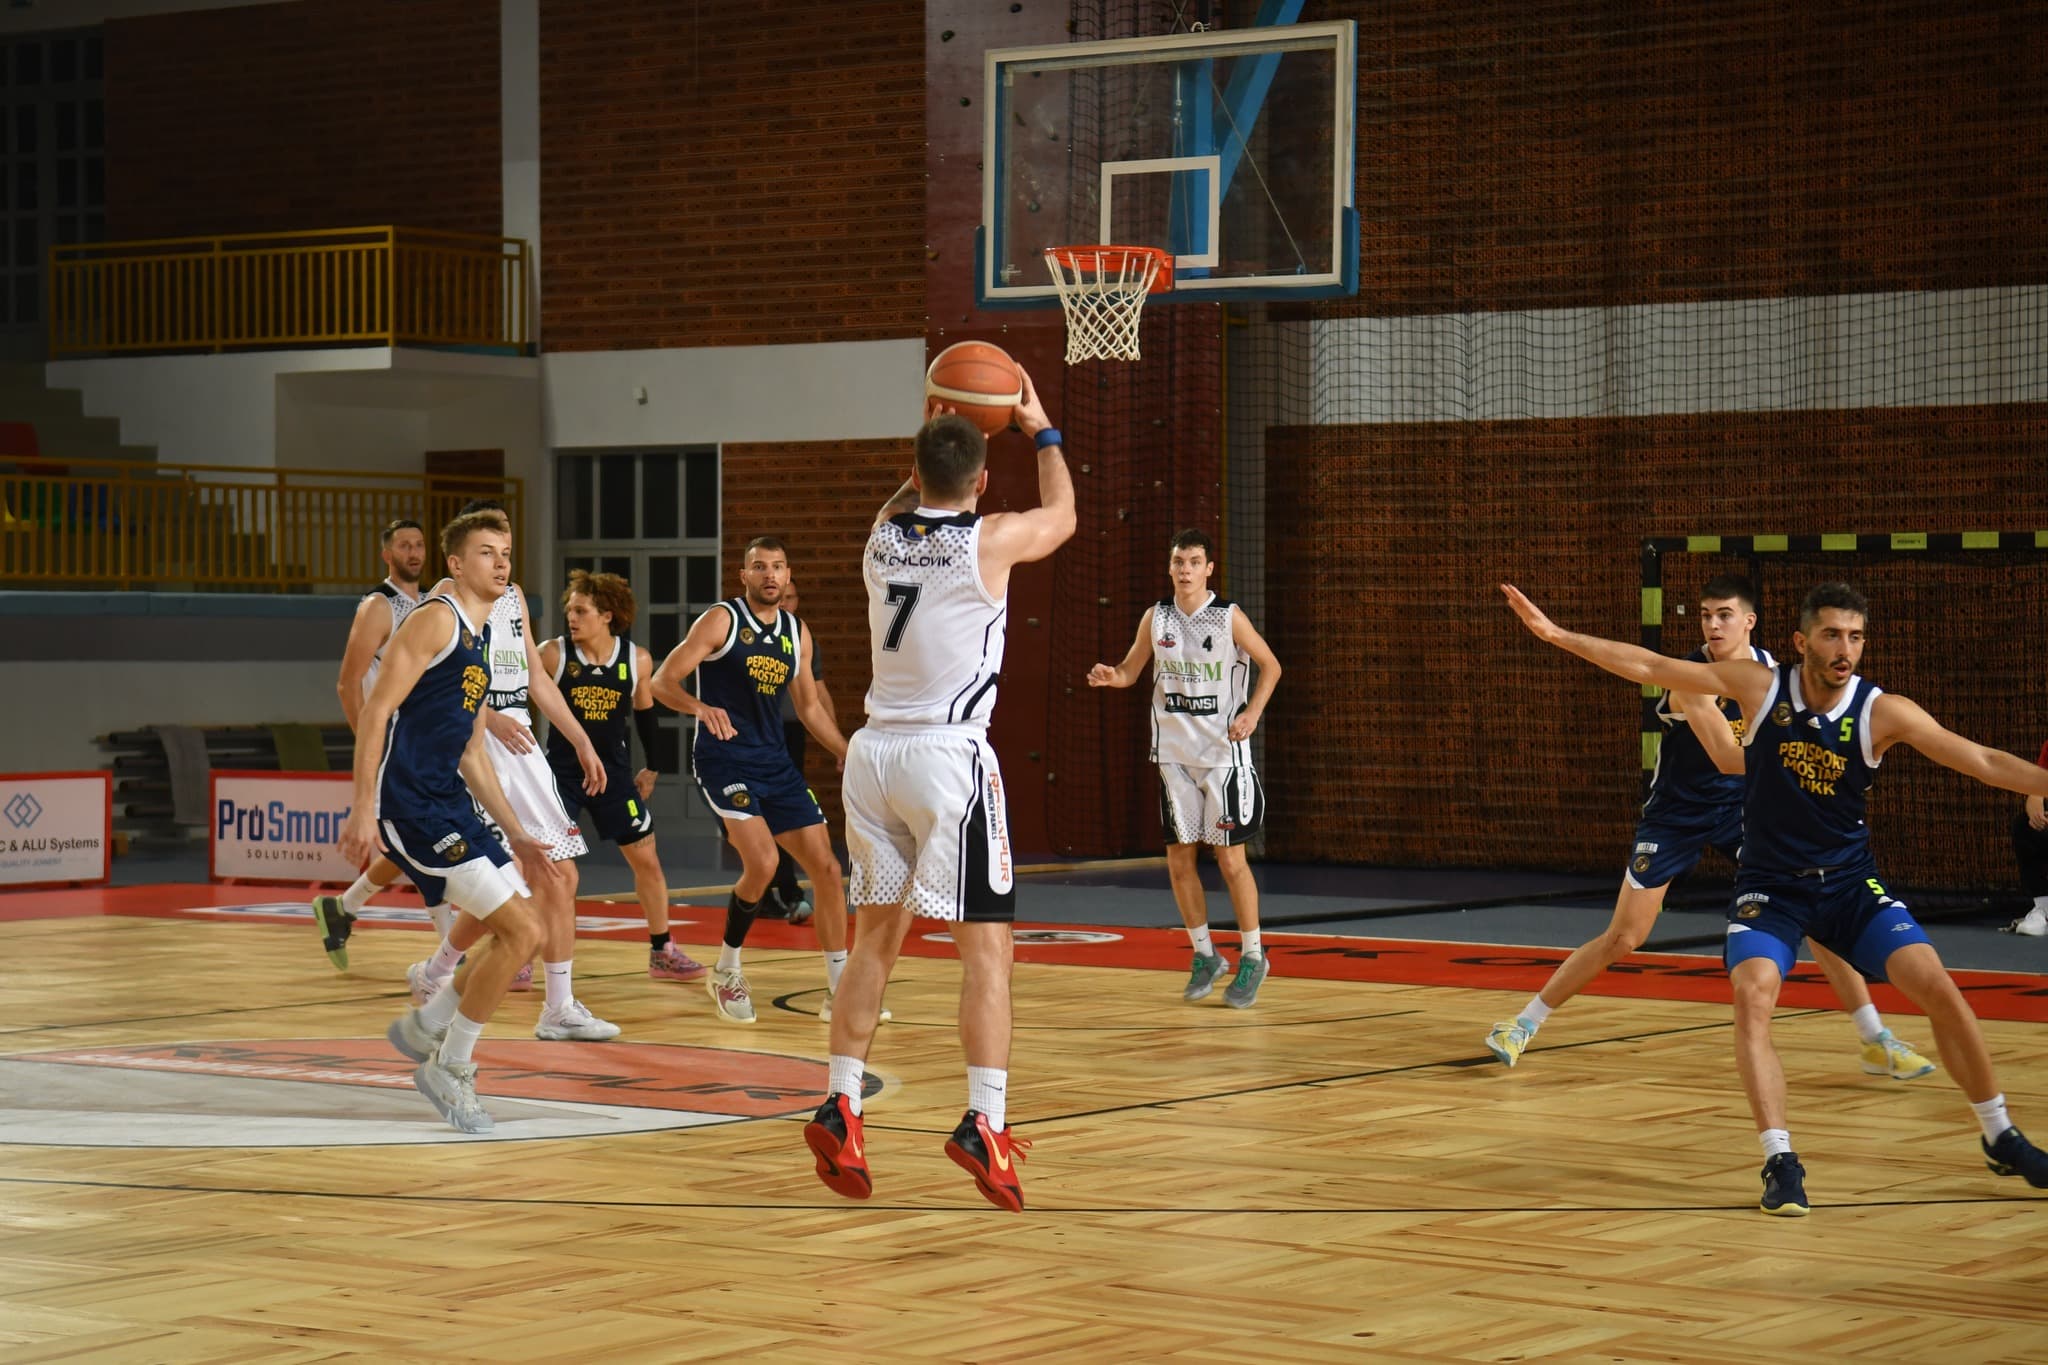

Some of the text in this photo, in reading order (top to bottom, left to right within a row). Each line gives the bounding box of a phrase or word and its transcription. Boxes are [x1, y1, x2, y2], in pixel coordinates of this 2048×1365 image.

[883, 581, 922, 651] 7
[780, 635, 793, 655] 14
[1202, 635, 1213, 652] 4
[495, 650, 519, 664] SMIN
[746, 655, 790, 675] PEPISPORT
[618, 663, 628, 680] 8
[749, 667, 786, 684] MOSTAR
[571, 686, 622, 701] PEPISPORT
[757, 682, 776, 695] HKK
[574, 697, 617, 710] MOSTAR
[585, 711, 608, 720] HKK
[1839, 717, 1854, 742] 5
[1779, 742, 1848, 770] PEPISPORT
[1783, 757, 1843, 781] MOSTAR
[1800, 778, 1836, 796] HKK
[627, 799, 638, 817] 8
[219, 799, 352, 844] ProSmar
[9, 840, 18, 852] &
[22, 839, 47, 851] ALU
[50, 837, 99, 853] Systems
[247, 849, 322, 862] SOLUTIONS
[1866, 878, 1885, 895] 5
[123, 1043, 832, 1101] ROCPUR
